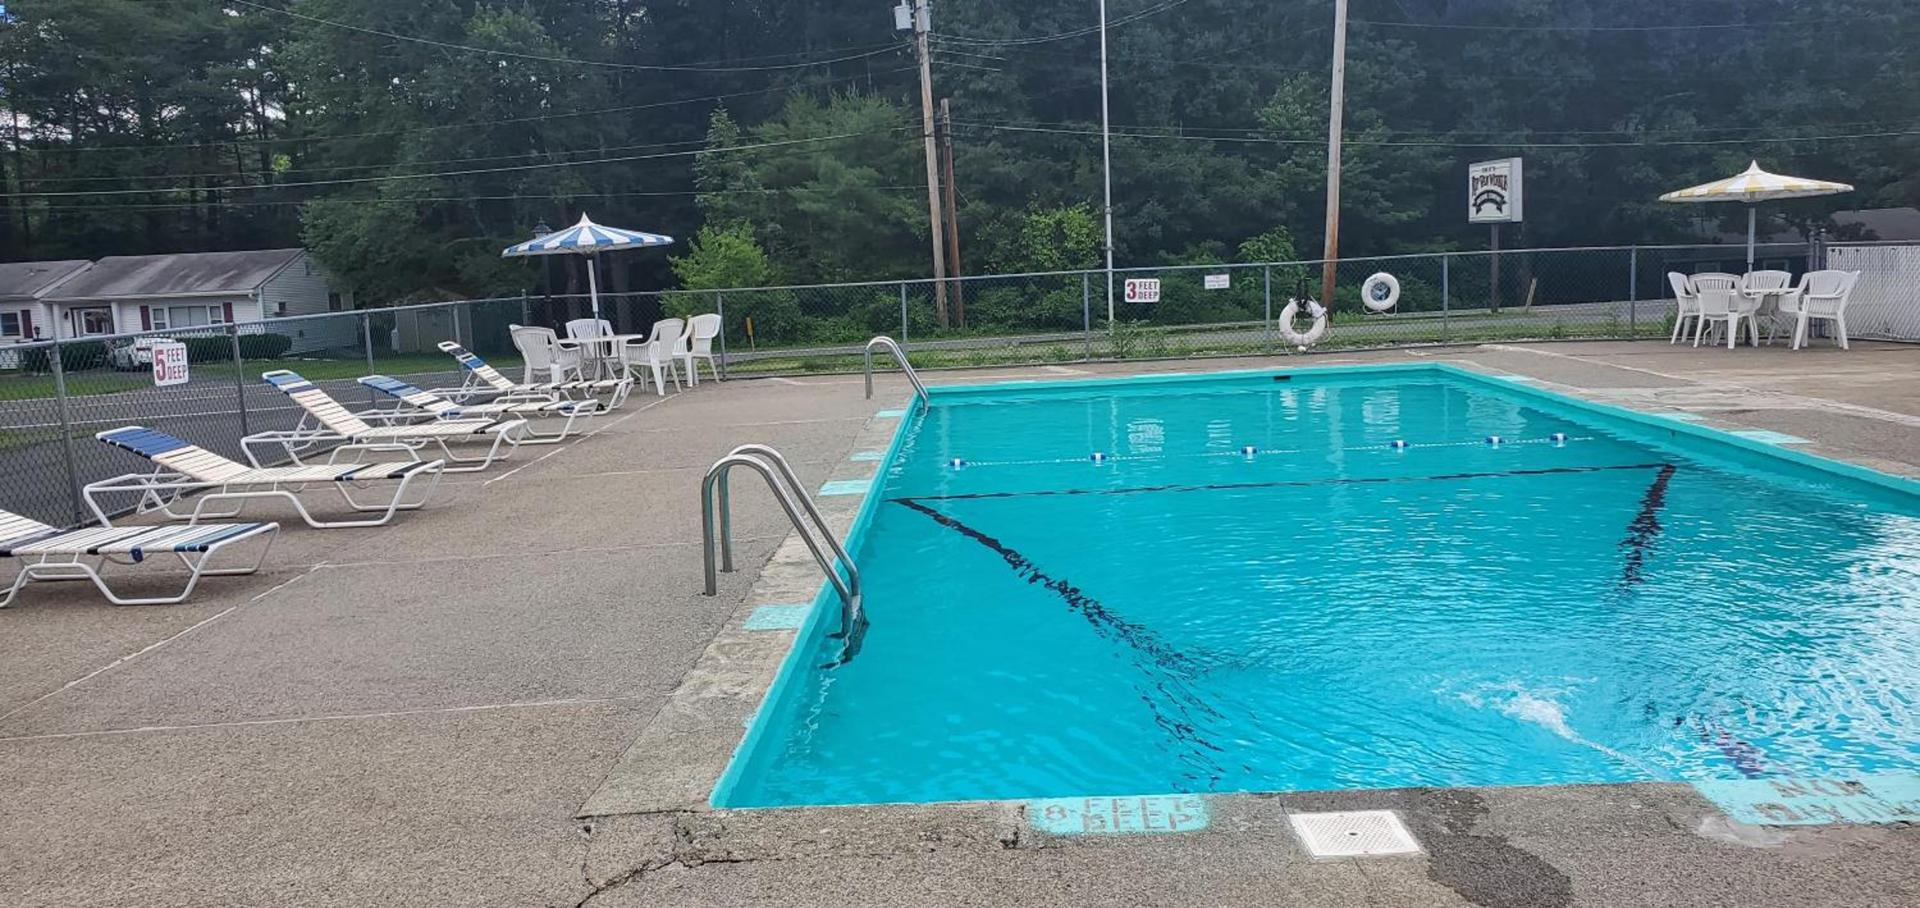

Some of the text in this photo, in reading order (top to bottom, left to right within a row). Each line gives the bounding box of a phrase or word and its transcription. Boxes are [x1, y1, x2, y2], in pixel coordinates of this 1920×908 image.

[1126, 281, 1136, 299] 3
[1138, 281, 1158, 290] FEET
[1138, 291, 1158, 300] DEEP
[167, 348, 184, 363] FEET
[155, 349, 166, 381] 5
[167, 365, 187, 380] DEEP
[1084, 798, 1183, 815] FEET
[1081, 813, 1193, 831] DEEP
